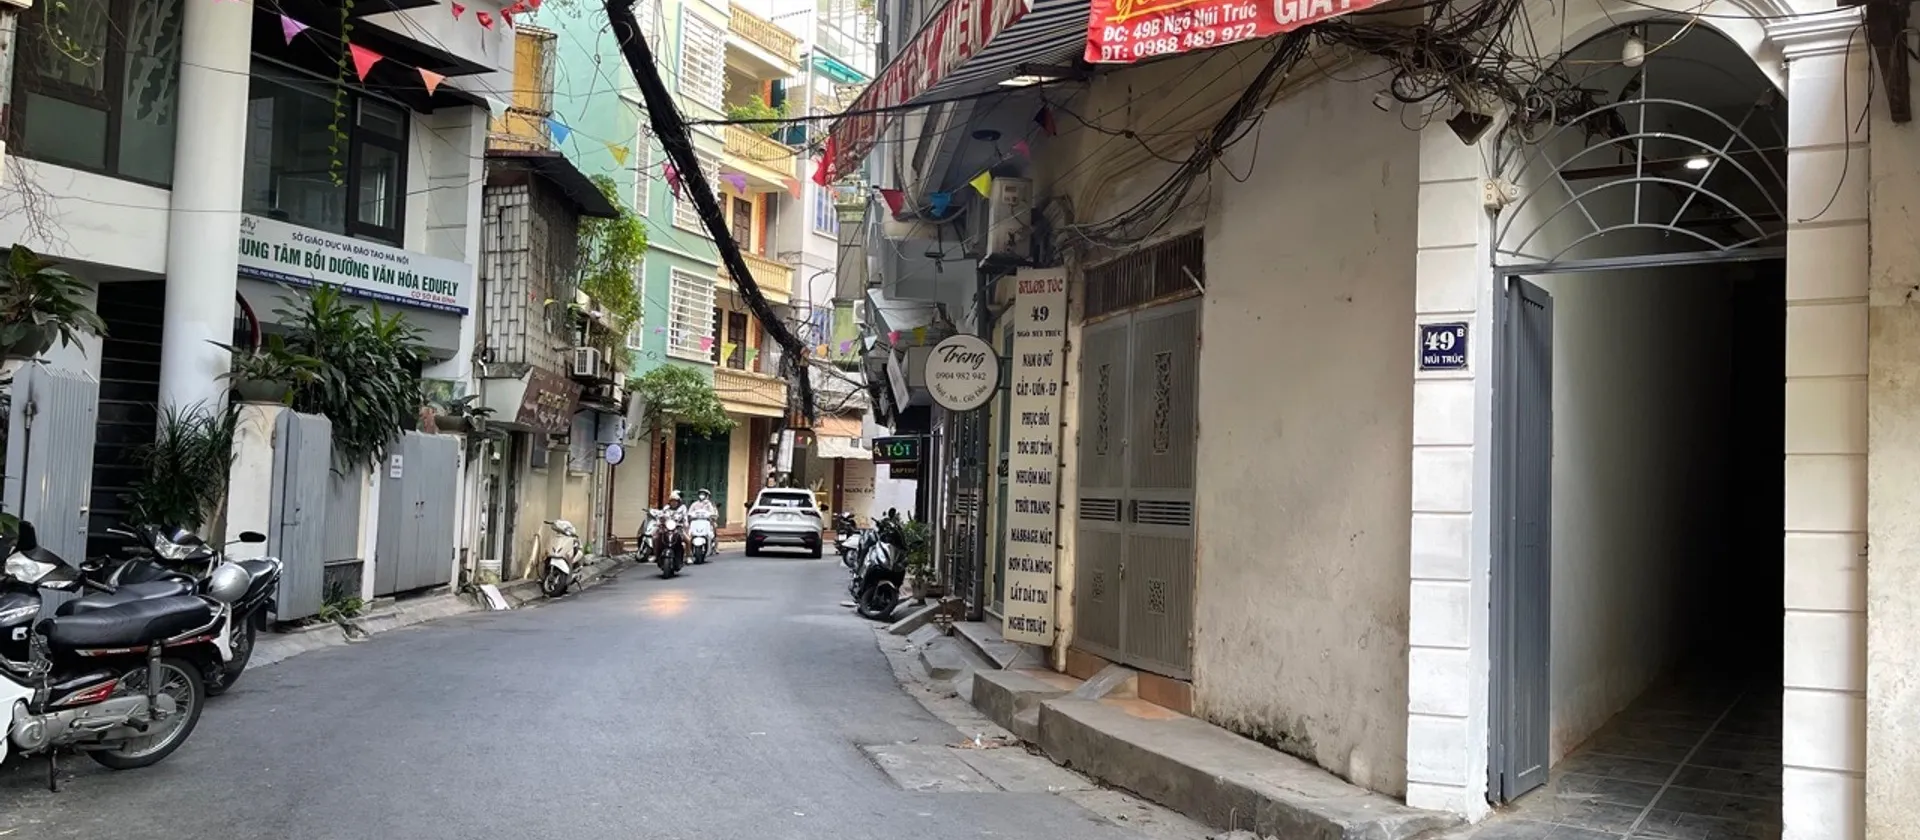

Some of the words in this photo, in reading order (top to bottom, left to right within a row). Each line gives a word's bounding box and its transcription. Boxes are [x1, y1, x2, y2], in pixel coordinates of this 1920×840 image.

[1103, 25, 1128, 42] ĐC:
[1132, 20, 1160, 39] 49B
[1163, 11, 1191, 35] Ngõ
[1193, 6, 1218, 27] Núi
[1222, 1, 1257, 23] Trúc
[1101, 44, 1128, 61] ĐT:
[1133, 36, 1178, 56] 0988
[1183, 28, 1215, 48] 489
[1221, 22, 1257, 42] 972
[292, 231, 303, 241] SỞ
[304, 234, 324, 246] GIÁO
[325, 240, 341, 250] DỤC
[342, 243, 352, 253] VÀ
[353, 245, 369, 256] ĐÀO
[370, 249, 384, 260] TẠO
[385, 252, 395, 262] HÀ
[396, 255, 409, 265] NỘI
[239, 238, 270, 260] UNG
[273, 243, 301, 267] TÂM
[304, 248, 326, 271] BỒI
[328, 256, 369, 280] DƯỠNG
[372, 264, 395, 285] VĂN
[397, 268, 419, 290] HÓA
[421, 276, 459, 297] EDUFLY
[1047, 277, 1063, 293] TÓC
[1030, 305, 1049, 322] 49
[938, 344, 986, 370] Trang
[1022, 353, 1036, 367] NAM
[1424, 353, 1440, 364] NÚI
[1442, 352, 1464, 364] TRÚC
[935, 372, 954, 380] 0904
[955, 372, 970, 380] 982
[972, 372, 987, 380] 942
[1017, 437, 1029, 454] TÓC
[1030, 500, 1051, 514] TRANG
[1011, 528, 1038, 543] MASSAGE
